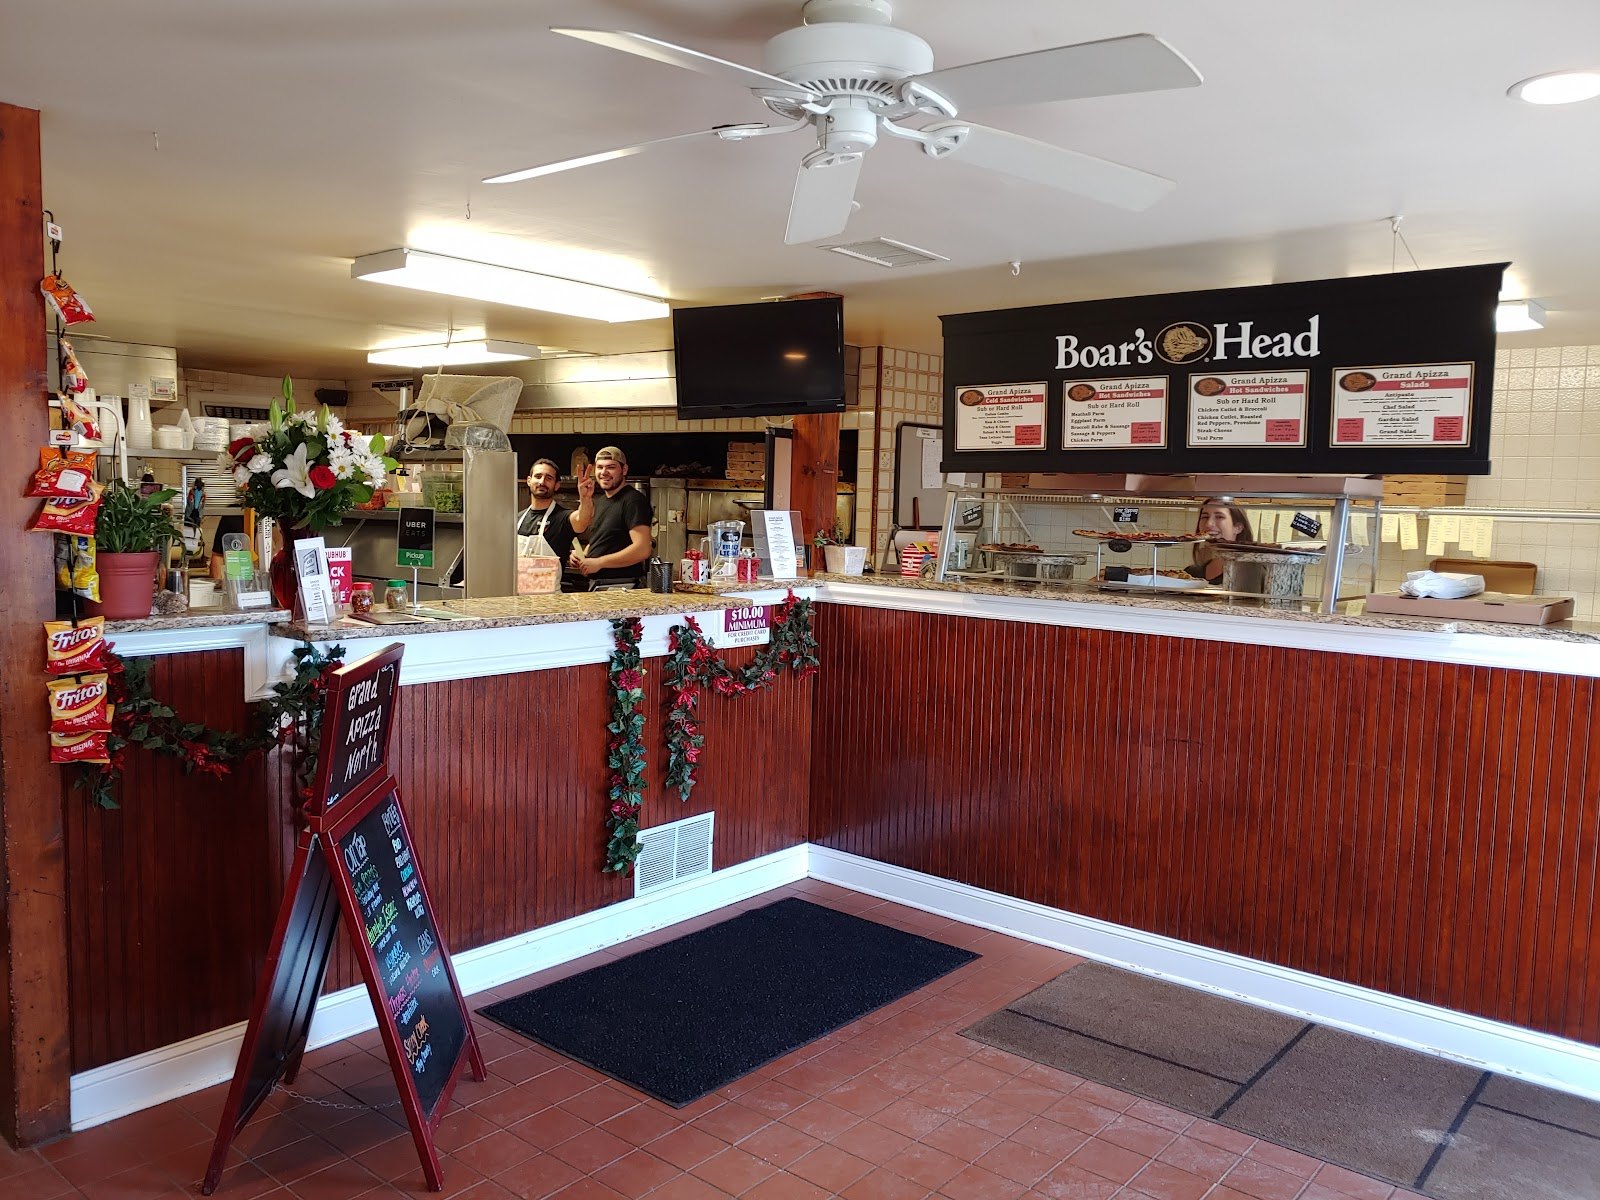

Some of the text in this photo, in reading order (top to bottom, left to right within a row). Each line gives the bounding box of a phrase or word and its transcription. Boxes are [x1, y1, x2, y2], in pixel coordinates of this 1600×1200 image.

[1055, 314, 1320, 369] Boar's Head
[1259, 377, 1288, 385] Apizza
[1382, 371, 1449, 379] Grand Apizza
[1124, 383, 1150, 391] Apizza
[330, 566, 345, 577] CK
[732, 606, 763, 621] $10.00
[729, 619, 766, 631] MINIMUM
[52, 626, 98, 651] Fritos
[56, 682, 103, 710] Fritos
[348, 669, 380, 711] Grand
[73, 710, 99, 724] ORIGINAL
[70, 739, 94, 752] ORIGINAL
[344, 732, 378, 782] North
